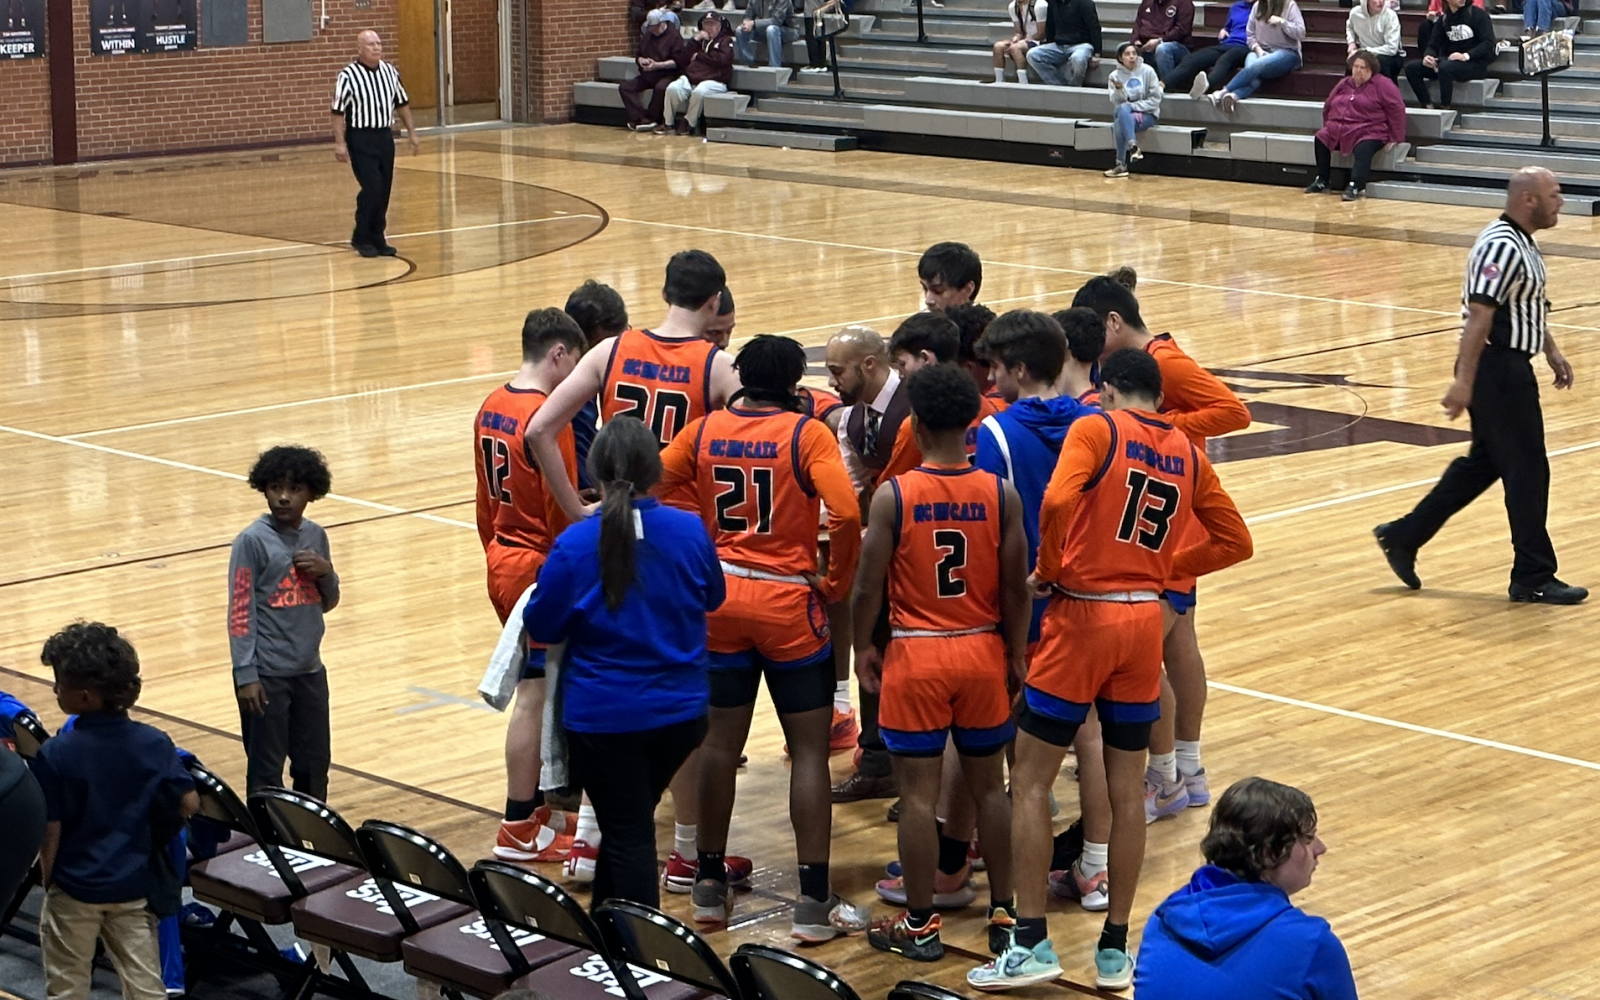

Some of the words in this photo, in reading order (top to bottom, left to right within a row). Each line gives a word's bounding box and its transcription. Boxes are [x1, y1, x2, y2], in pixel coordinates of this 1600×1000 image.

[0, 42, 35, 54] KEEPER
[101, 38, 135, 51] WITHIN
[156, 34, 186, 45] HUSTLE
[613, 381, 691, 449] 20
[481, 435, 513, 507] 12
[712, 465, 773, 534] 21
[1115, 467, 1181, 554] 13
[932, 528, 968, 599] 2
